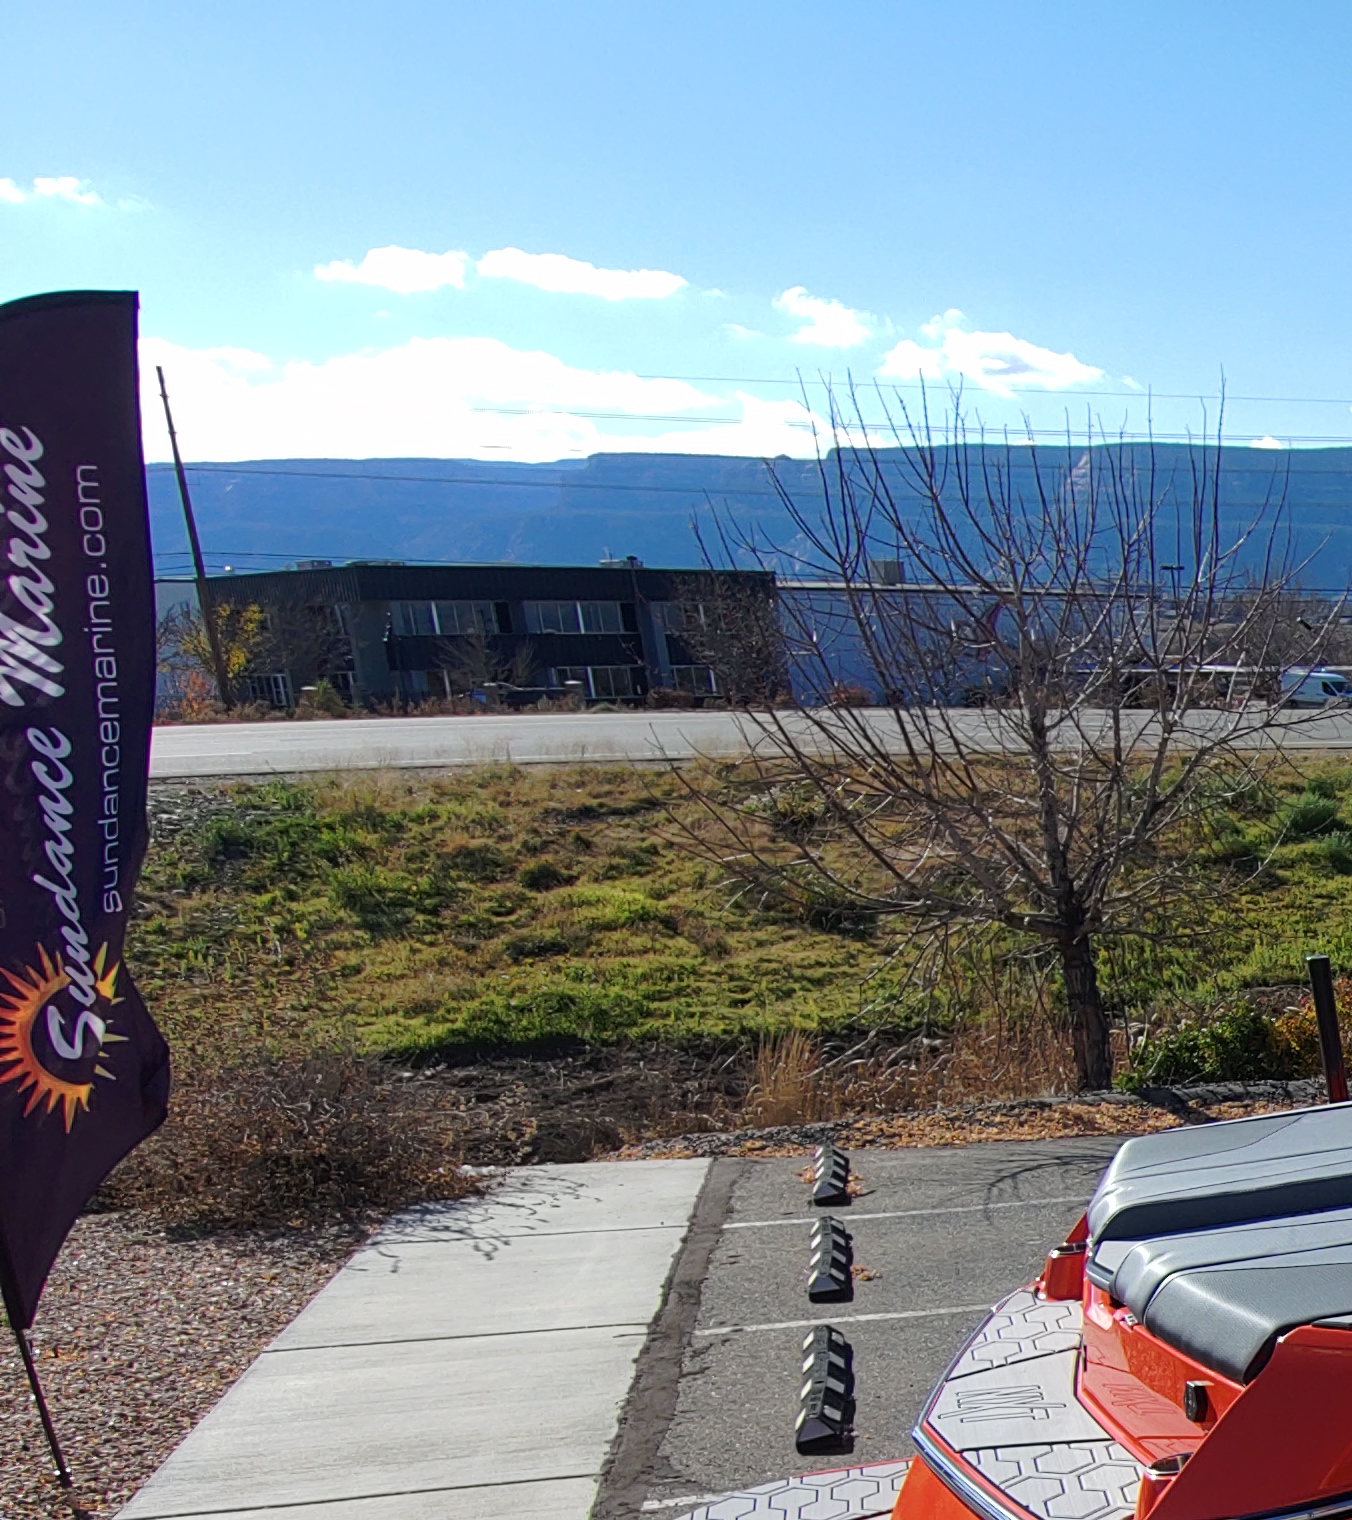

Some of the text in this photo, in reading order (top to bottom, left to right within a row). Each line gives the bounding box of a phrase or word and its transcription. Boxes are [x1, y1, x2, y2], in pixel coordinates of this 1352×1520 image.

[0, 425, 106, 1060] Sundance Marine
[76, 465, 122, 913] sundancemarine.com
